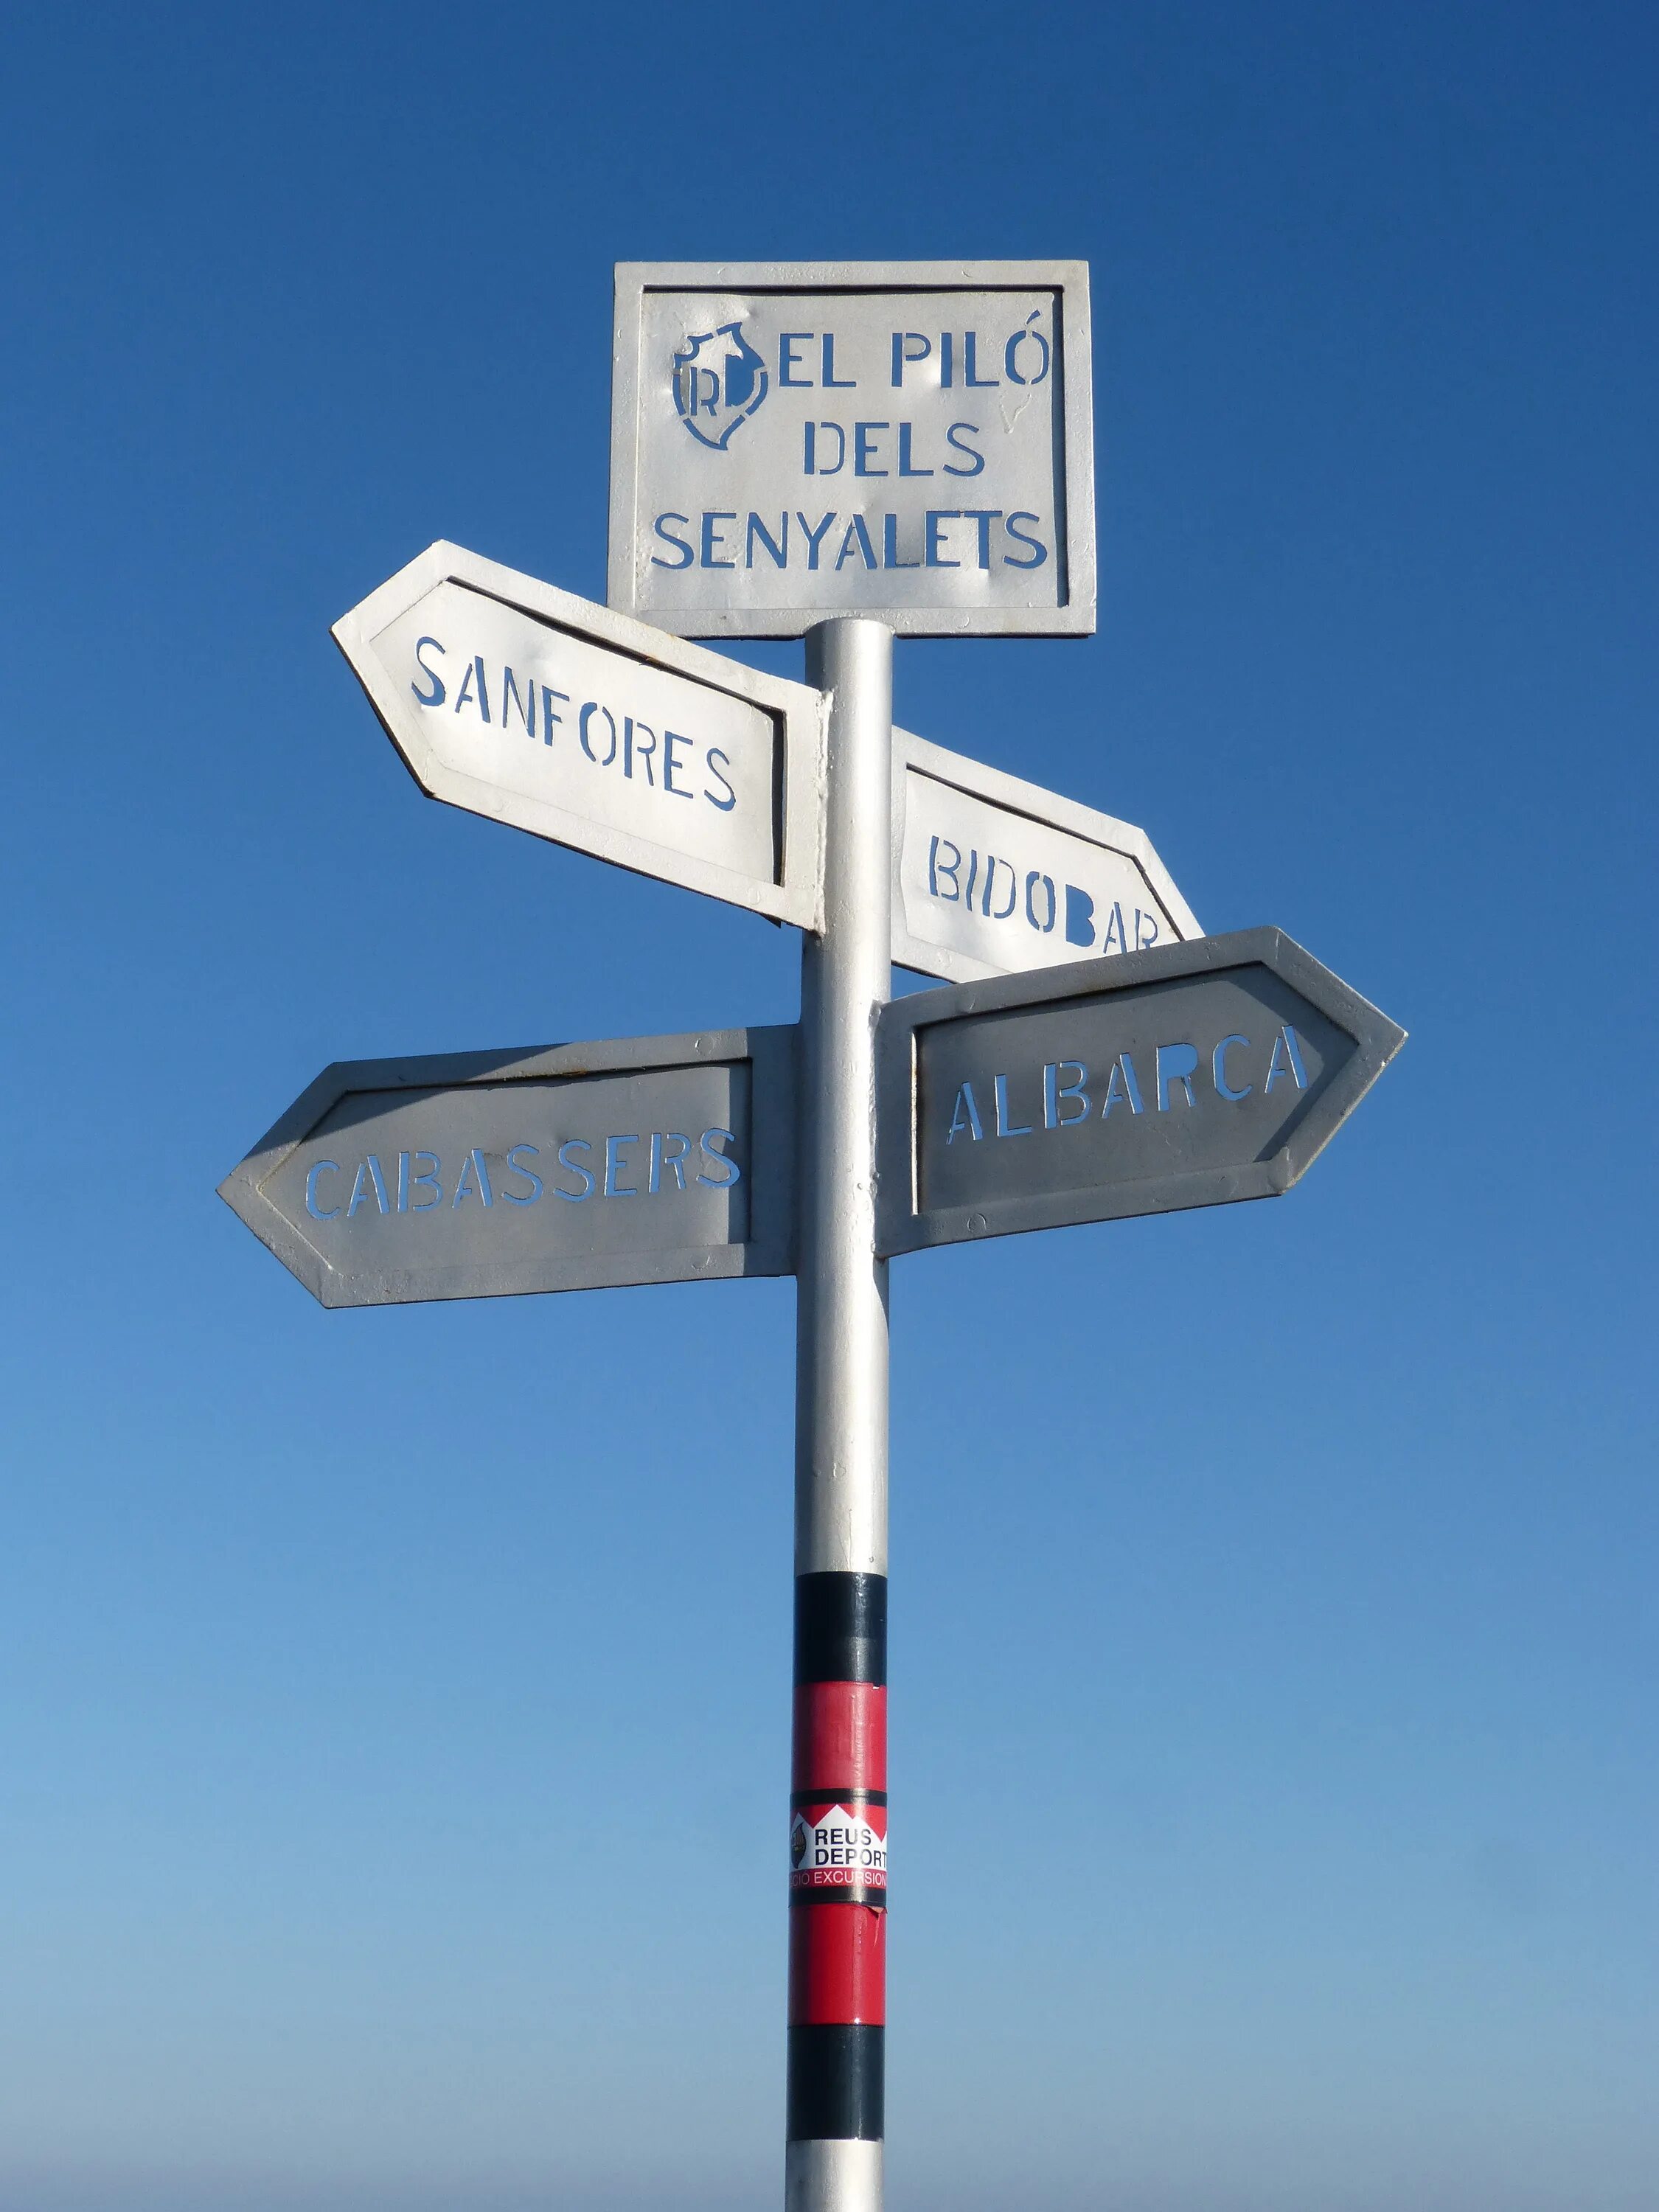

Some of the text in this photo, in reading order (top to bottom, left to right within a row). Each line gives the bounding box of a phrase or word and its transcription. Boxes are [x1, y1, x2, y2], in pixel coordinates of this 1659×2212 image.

[779, 310, 1050, 389] EL PILÓ
[803, 422, 985, 477] DELS
[650, 511, 1048, 571] SENYALETS
[411, 636, 737, 812] SANFORES
[928, 835, 1158, 954] BIDOBAR
[946, 1024, 1309, 1145] ALBARCA
[305, 1127, 740, 1220] CABASSERS
[815, 1829, 872, 1846] REUS
[815, 1848, 886, 1868] DEPORT
